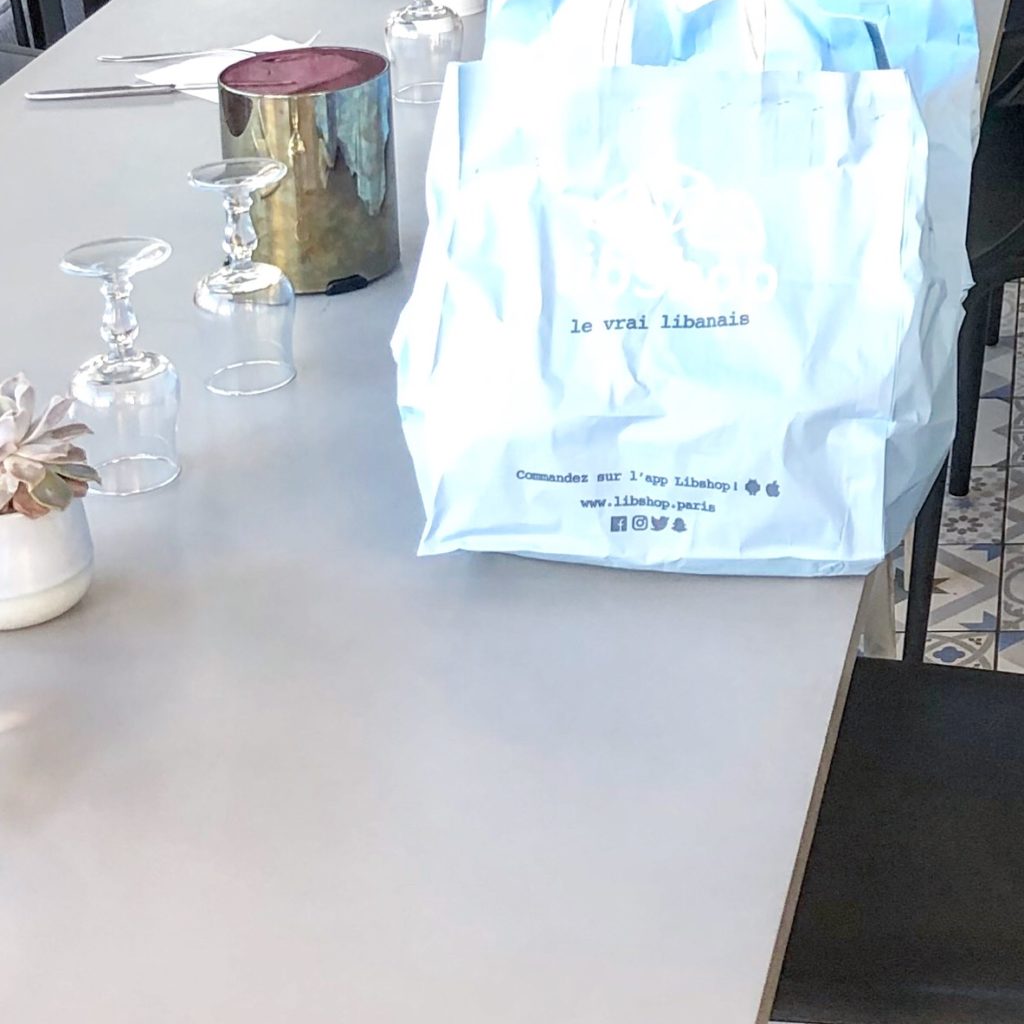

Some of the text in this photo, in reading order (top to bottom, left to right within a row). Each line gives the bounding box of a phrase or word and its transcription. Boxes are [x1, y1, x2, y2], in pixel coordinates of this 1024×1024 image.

[570, 311, 750, 334] le vrai libanais
[516, 469, 589, 484] Commandez
[597, 471, 622, 482] sur
[580, 495, 716, 513] www.libshop.paris
